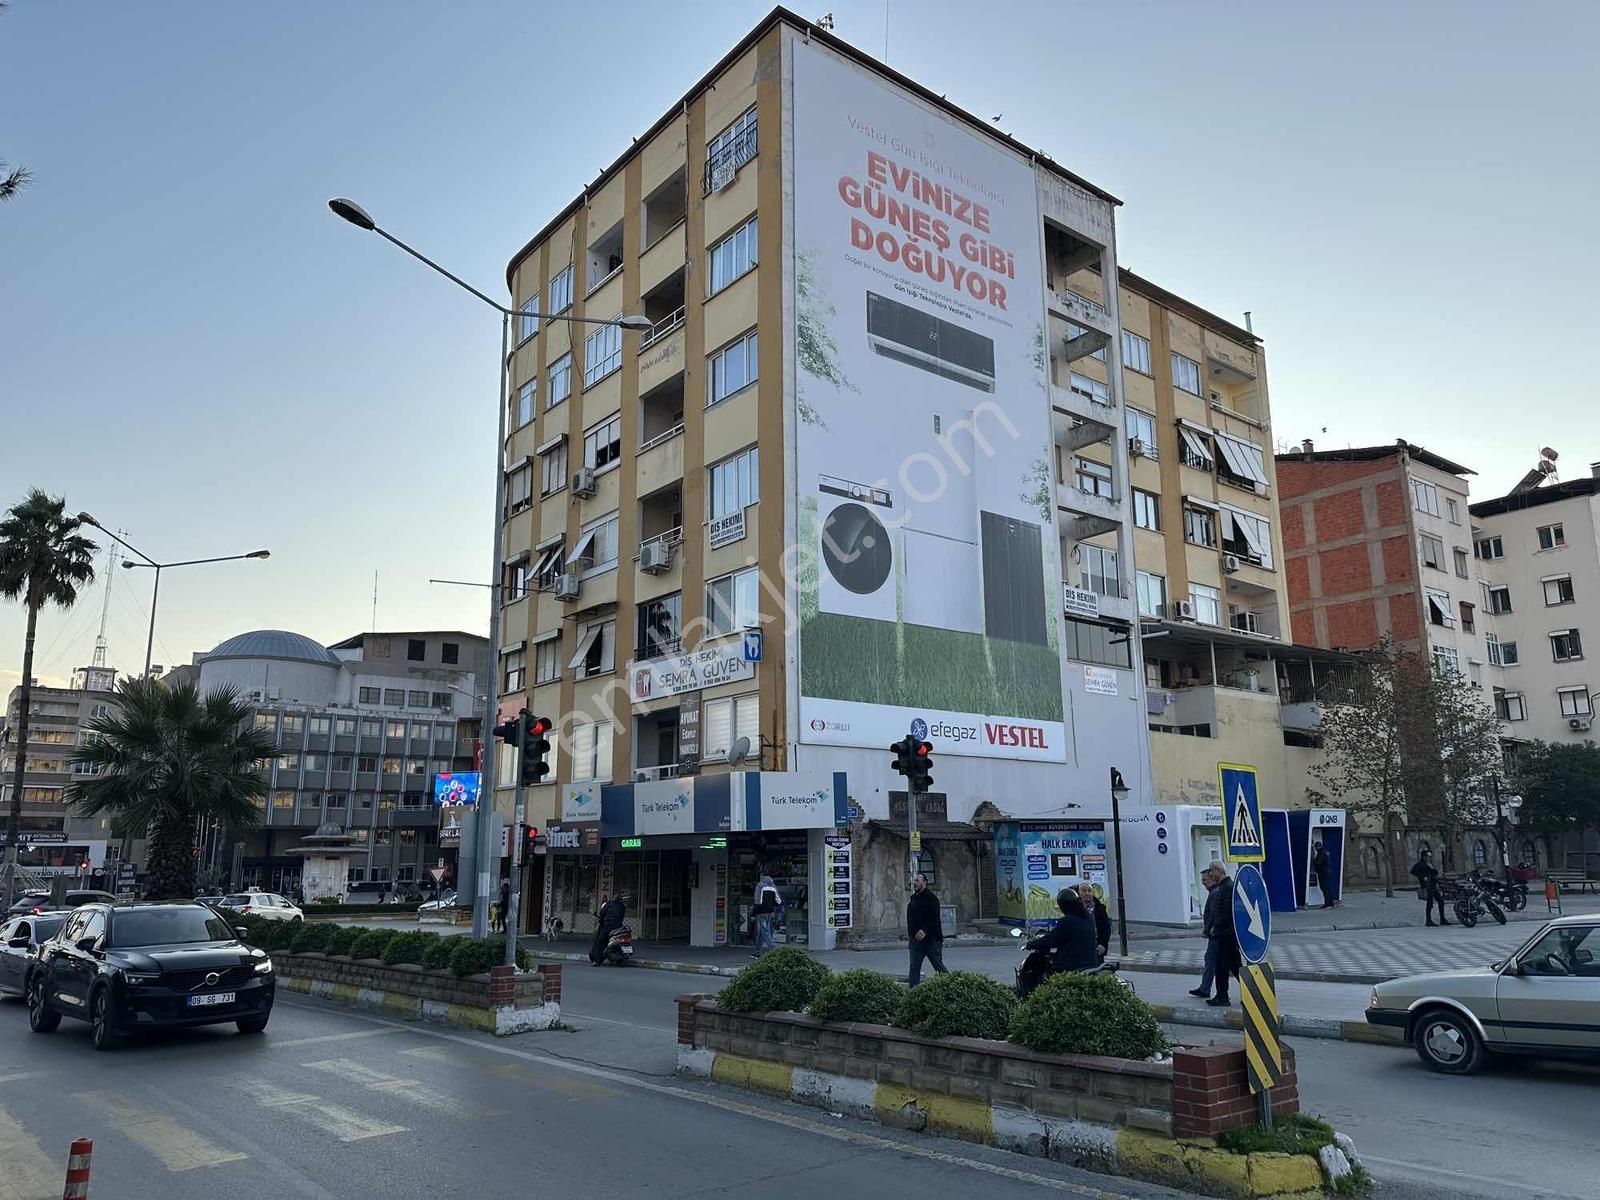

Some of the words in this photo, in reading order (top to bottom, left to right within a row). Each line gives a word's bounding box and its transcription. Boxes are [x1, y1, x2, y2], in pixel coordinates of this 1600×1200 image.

[848, 115, 887, 144] Vestel
[891, 137, 917, 161] Gün
[838, 176, 950, 252] GÜNEŞ
[850, 217, 1008, 311] DOĞUYOR
[659, 669, 698, 689] SEMRA
[703, 656, 748, 679] GÜVEN
[930, 721, 977, 742] efegaz
[984, 722, 1049, 750] VESTEL
[655, 801, 680, 813] Telekom
[788, 796, 818, 805] Telekom
[1325, 814, 1338, 824] QNB
[1041, 839, 1060, 849] HALK
[1061, 839, 1088, 849] EKMEK
[222, 993, 234, 1002] 731
